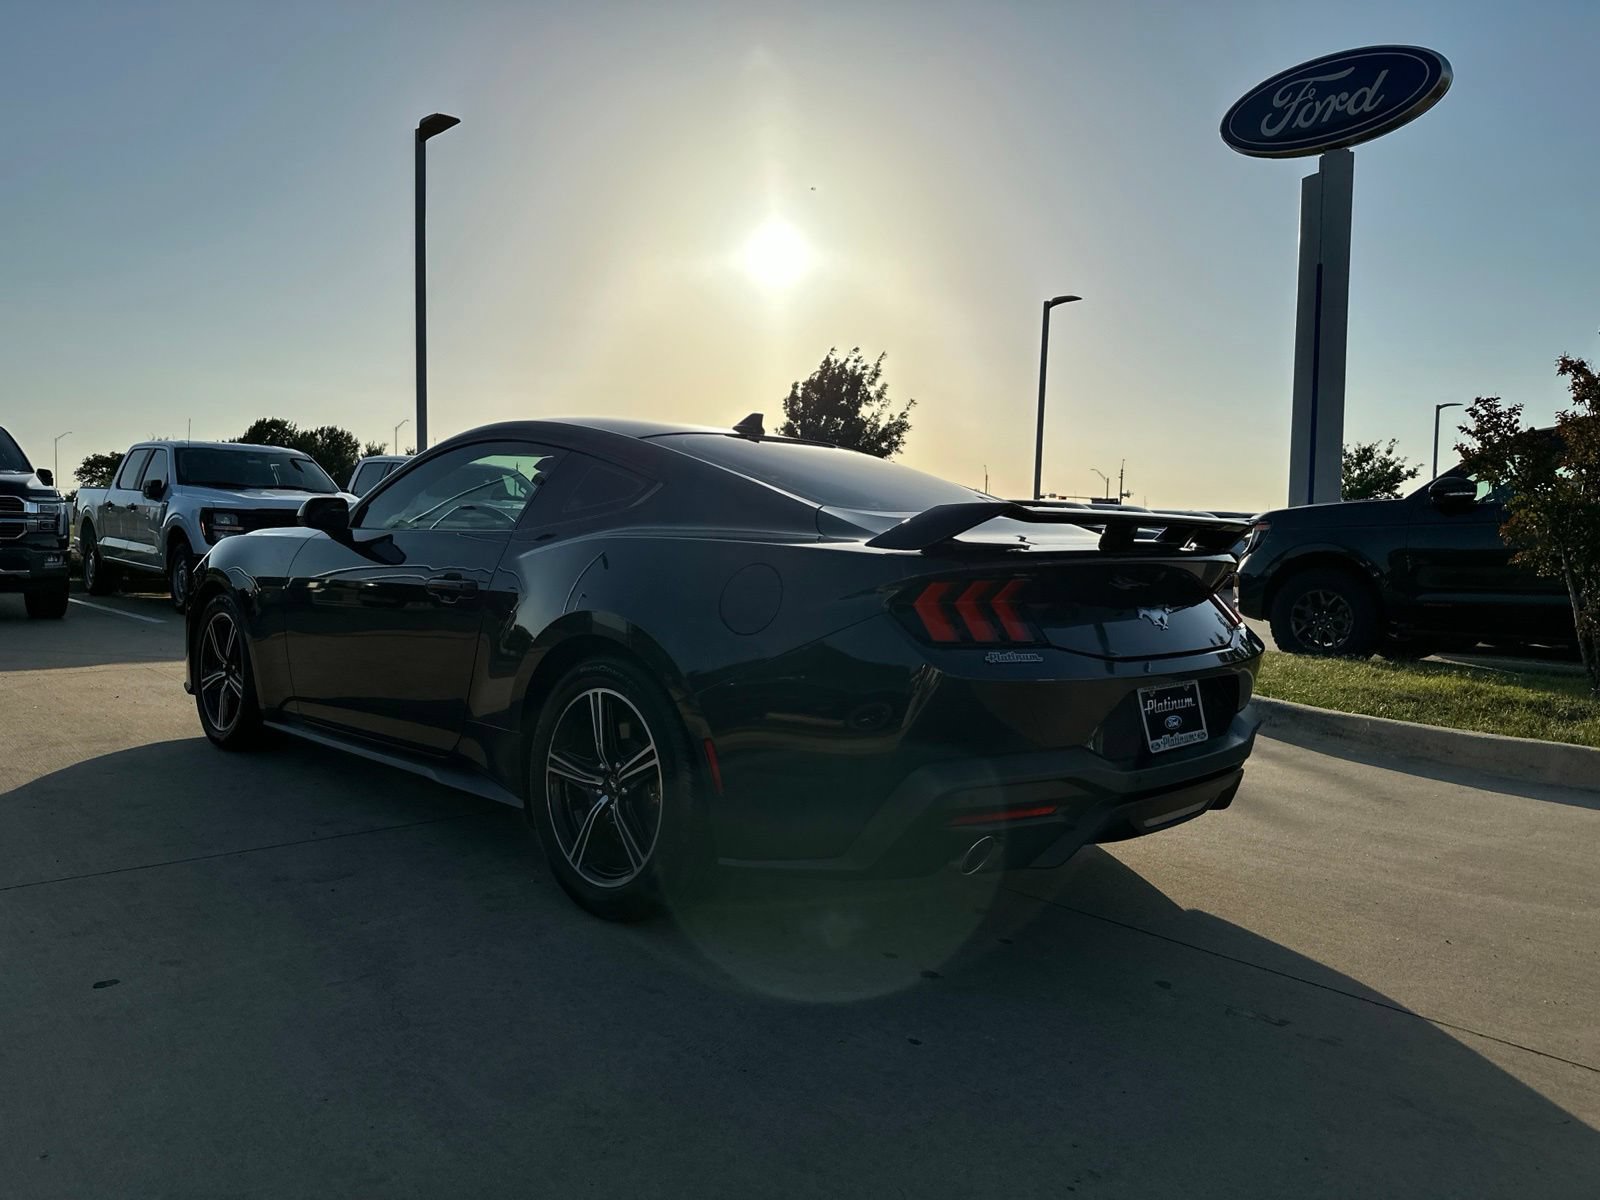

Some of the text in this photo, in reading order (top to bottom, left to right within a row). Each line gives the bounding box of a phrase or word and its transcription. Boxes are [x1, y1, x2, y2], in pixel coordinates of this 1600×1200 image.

[1260, 66, 1389, 137] Ford
[985, 651, 1044, 663] Platinum
[1144, 696, 1196, 715] Platinum
